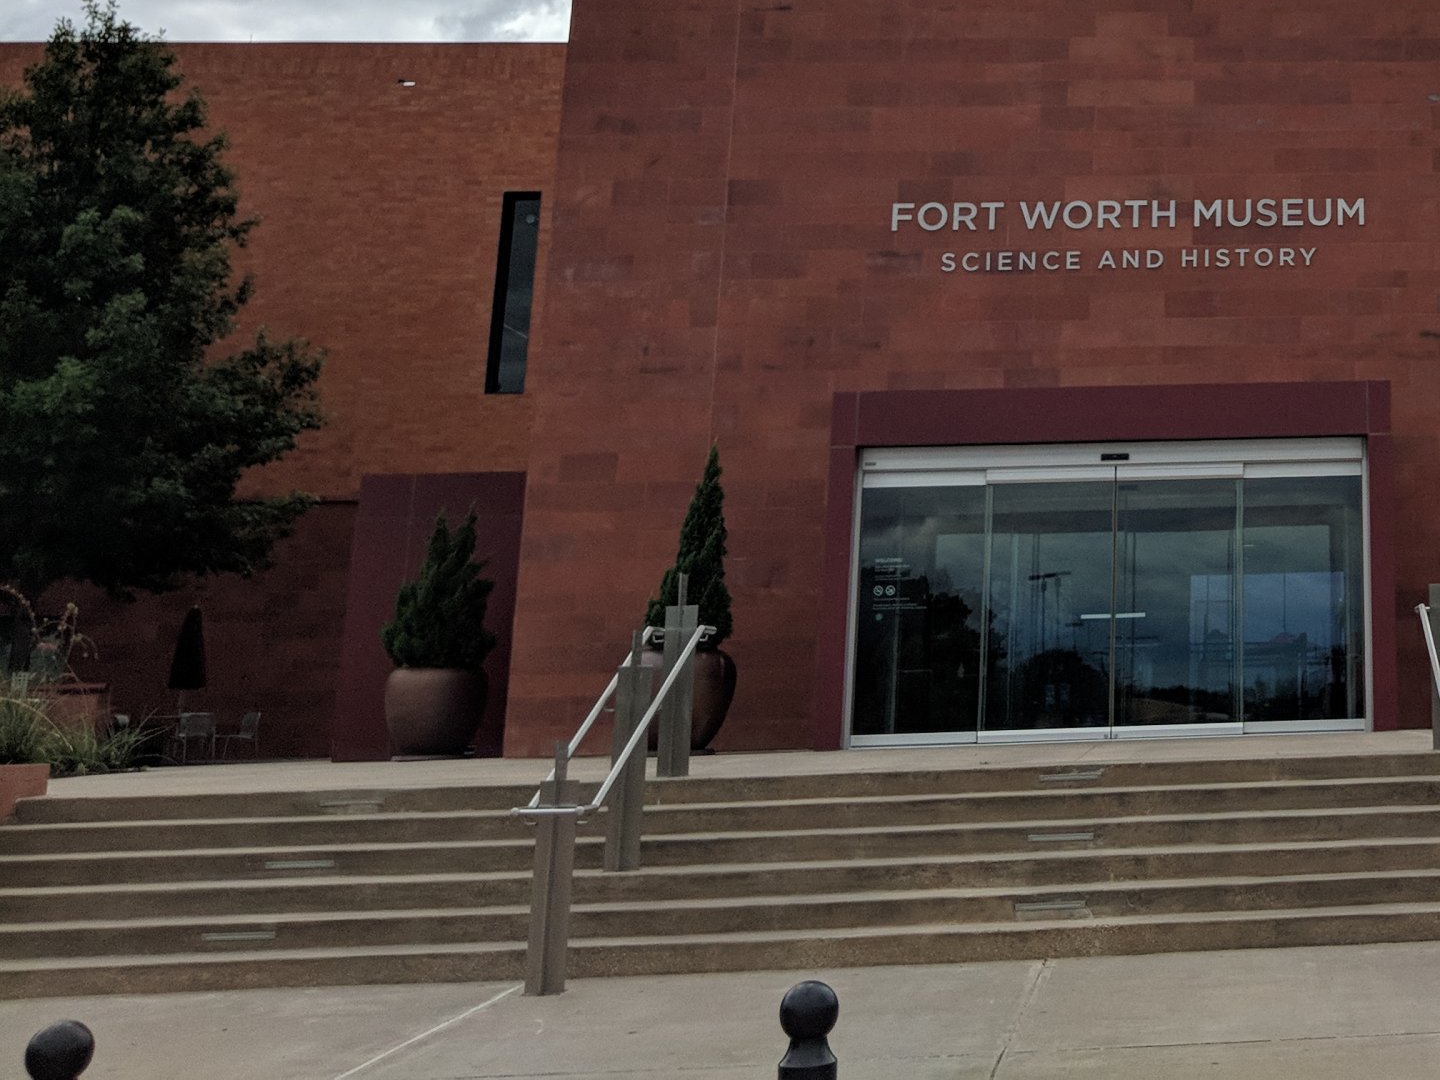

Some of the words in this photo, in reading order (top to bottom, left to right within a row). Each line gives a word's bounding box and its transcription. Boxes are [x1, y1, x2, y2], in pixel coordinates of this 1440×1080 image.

[890, 201, 1005, 231] FORT
[1019, 199, 1176, 230] WORTH
[1193, 197, 1365, 227] MUSEUM
[940, 250, 1082, 272] SCIENCE
[1097, 248, 1164, 270] AND
[1181, 246, 1318, 268] HISTORY
